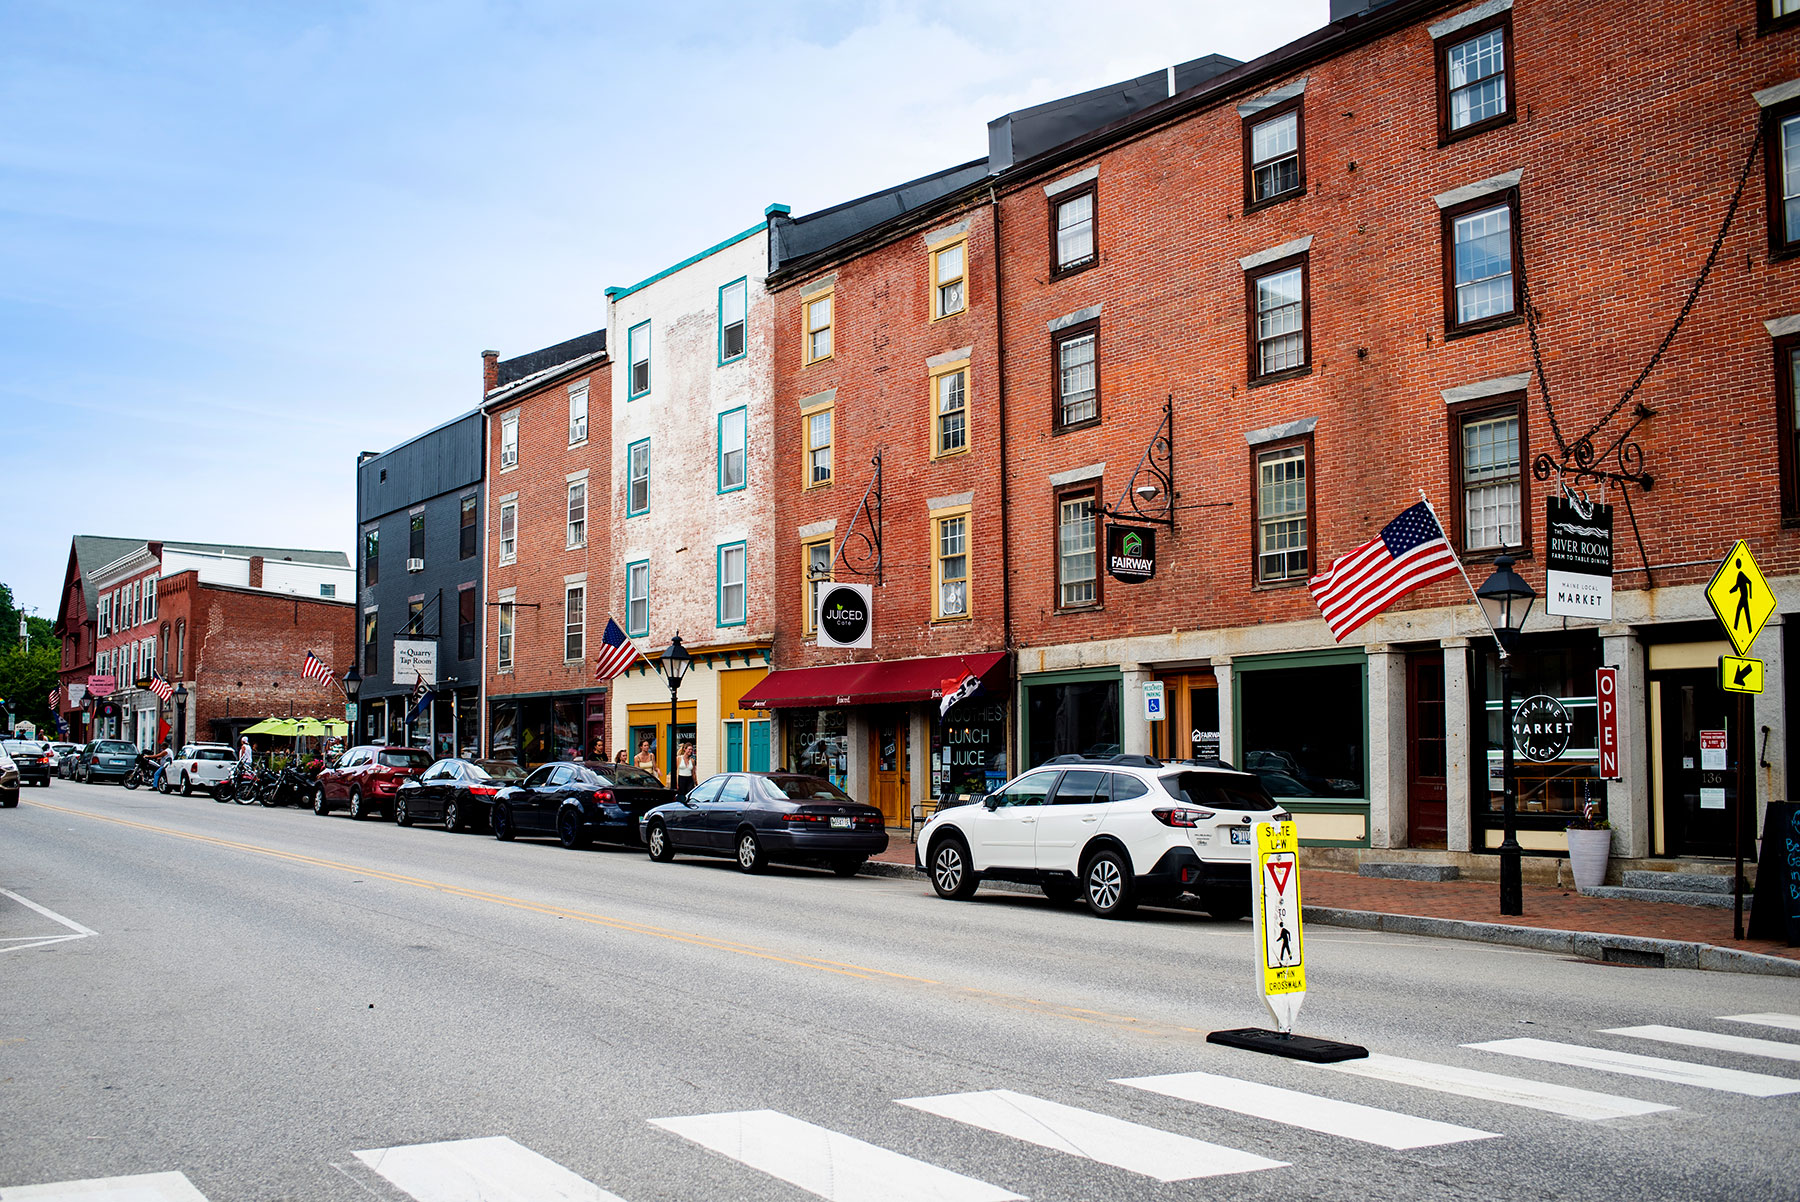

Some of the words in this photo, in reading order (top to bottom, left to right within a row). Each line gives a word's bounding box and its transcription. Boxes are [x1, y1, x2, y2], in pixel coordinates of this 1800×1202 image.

[1554, 528, 1562, 536] THE
[1552, 537, 1578, 553] RIVER
[1581, 541, 1609, 557] ROOM
[1111, 555, 1153, 571] FAIRWAY
[1552, 552, 1565, 560] FARM
[1575, 555, 1590, 563] TABLE
[1591, 557, 1609, 566] DINING
[1561, 582, 1579, 590] MAINE
[1581, 584, 1599, 592] LOCAL
[1558, 591, 1602, 606] MARKET
[407, 648, 432, 658] Quarry
[401, 656, 412, 665] Tap
[413, 657, 432, 665] Room
[1521, 700, 1560, 718] MAINE
[1511, 722, 1573, 735] MARKET
[1600, 675, 1616, 771] OPEN
[800, 732, 837, 747] COFFEE
[948, 728, 990, 744] LUNCH
[1523, 741, 1561, 757] LOCAL
[809, 751, 828, 765] TEA
[952, 750, 986, 766] JUICE
[1702, 772, 1722, 784] 136
[1270, 839, 1287, 850] LAW
[1278, 908, 1286, 917] TO
